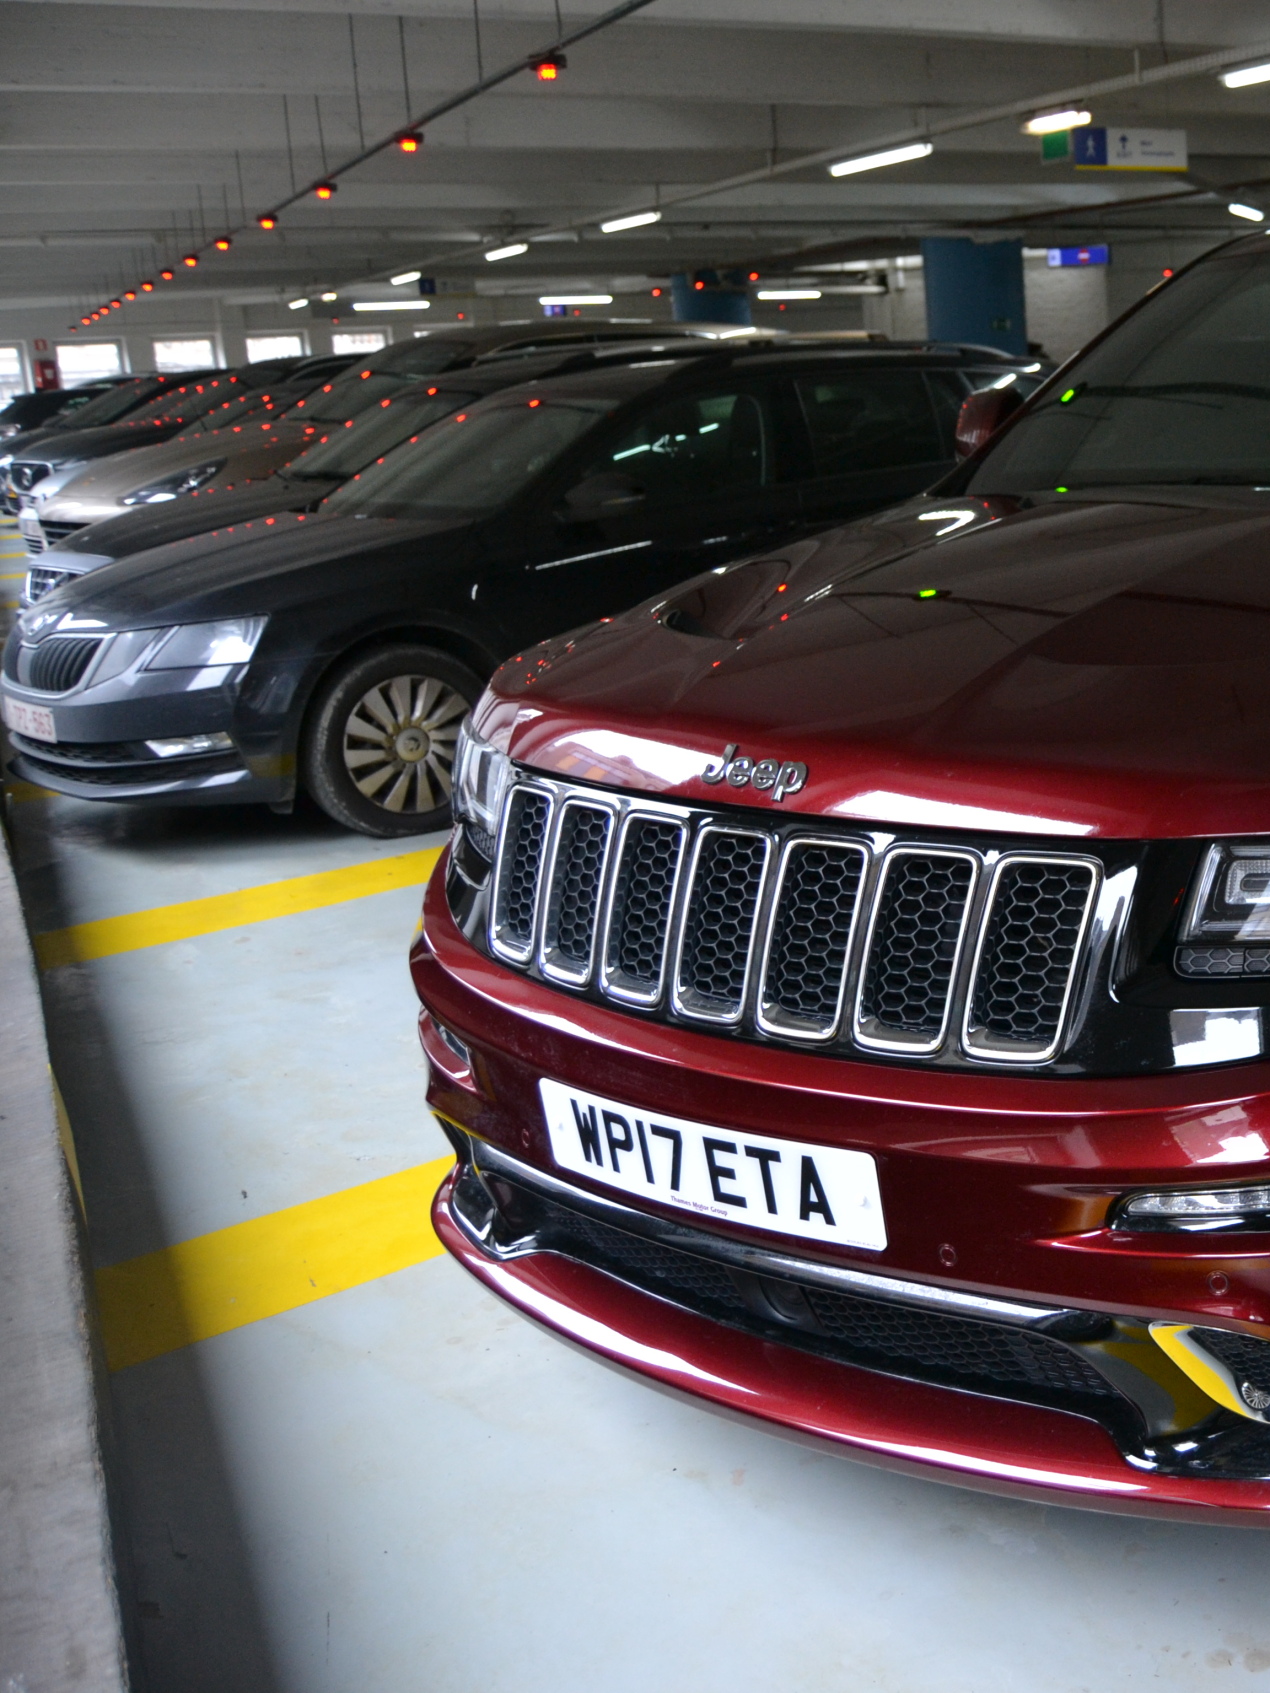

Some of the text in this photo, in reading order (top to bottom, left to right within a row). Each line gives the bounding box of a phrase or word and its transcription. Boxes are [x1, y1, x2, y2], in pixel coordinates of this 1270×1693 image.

[701, 743, 807, 802] Jeep
[570, 1098, 837, 1226] WP17 ETA
[671, 1195, 691, 1206] Thames
[710, 1206, 728, 1217] Group
